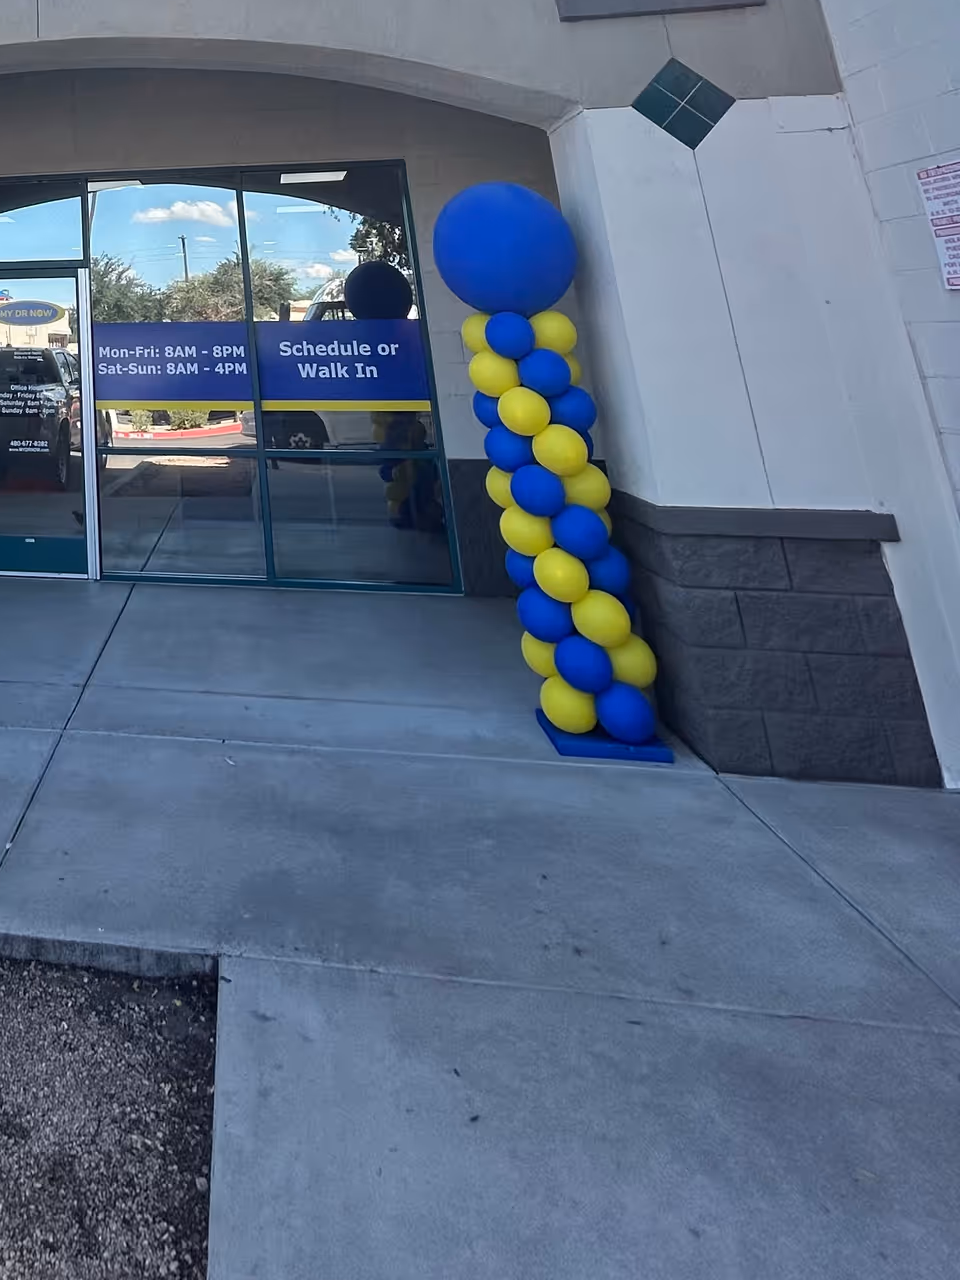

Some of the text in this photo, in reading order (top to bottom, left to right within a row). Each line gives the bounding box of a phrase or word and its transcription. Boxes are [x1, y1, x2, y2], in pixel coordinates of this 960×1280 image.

[0, 308, 53, 318] MY DR NOW
[98, 345, 160, 358] Mon-Fri:
[164, 345, 197, 358] 8AM
[212, 345, 245, 358] 8PM
[279, 340, 399, 356] Schedule or
[98, 362, 162, 375] Sat-Sun:
[166, 362, 199, 375] 8AM
[214, 362, 248, 375] 4PM
[297, 362, 378, 378] Walk In
[17, 391, 36, 399] Friday
